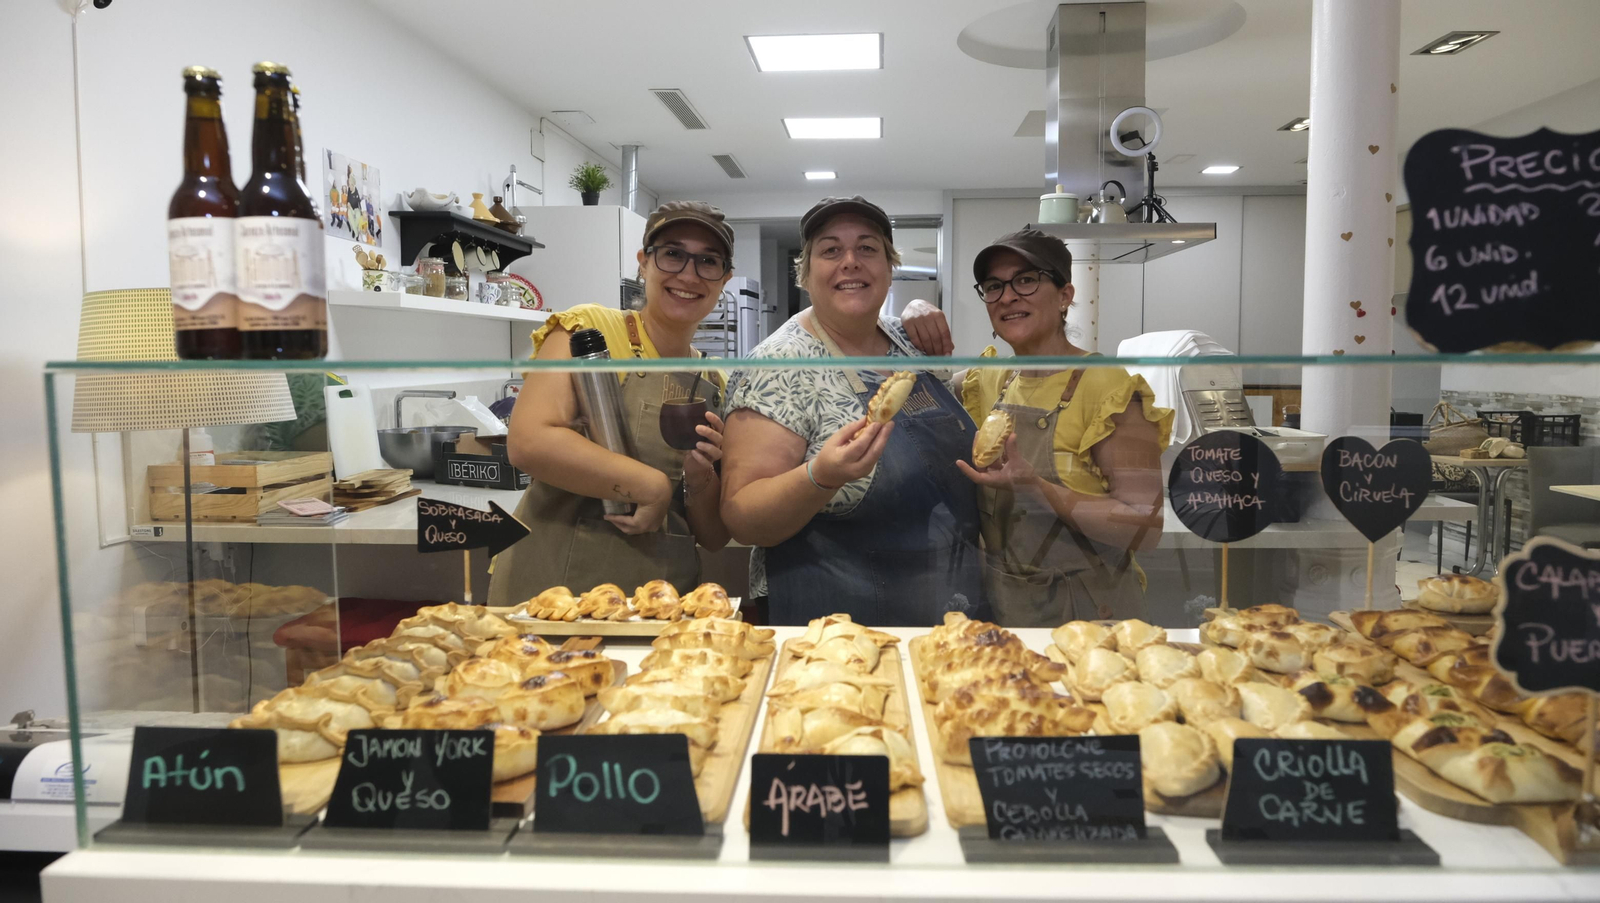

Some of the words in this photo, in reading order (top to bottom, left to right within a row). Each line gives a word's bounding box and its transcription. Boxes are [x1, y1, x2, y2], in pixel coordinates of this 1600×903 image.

[1425, 245, 1448, 271] 6
[1431, 284, 1479, 316] 12
[1187, 446, 1242, 464] TOMATE
[1337, 449, 1398, 471] BACON
[450, 462, 497, 480] IBÉRIKO
[1190, 467, 1243, 484] QUESO
[418, 501, 503, 523] SOBRASADA
[1187, 492, 1266, 510] ALBAHACA
[425, 525, 466, 544] QUESO
[348, 734, 422, 767] JAMON
[435, 732, 487, 767] YORK
[142, 750, 245, 792] Atún
[986, 763, 1076, 787] TOMATES
[1079, 761, 1135, 781] SECOS
[1253, 744, 1368, 785] CRIOLLA
[545, 753, 660, 804] Pollo
[1303, 780, 1336, 800] DE
[352, 782, 451, 812] QUESO
[763, 761, 869, 837] ÁRABE
[1259, 793, 1367, 827] CARNE
[993, 800, 1089, 824] CEBOLLA
